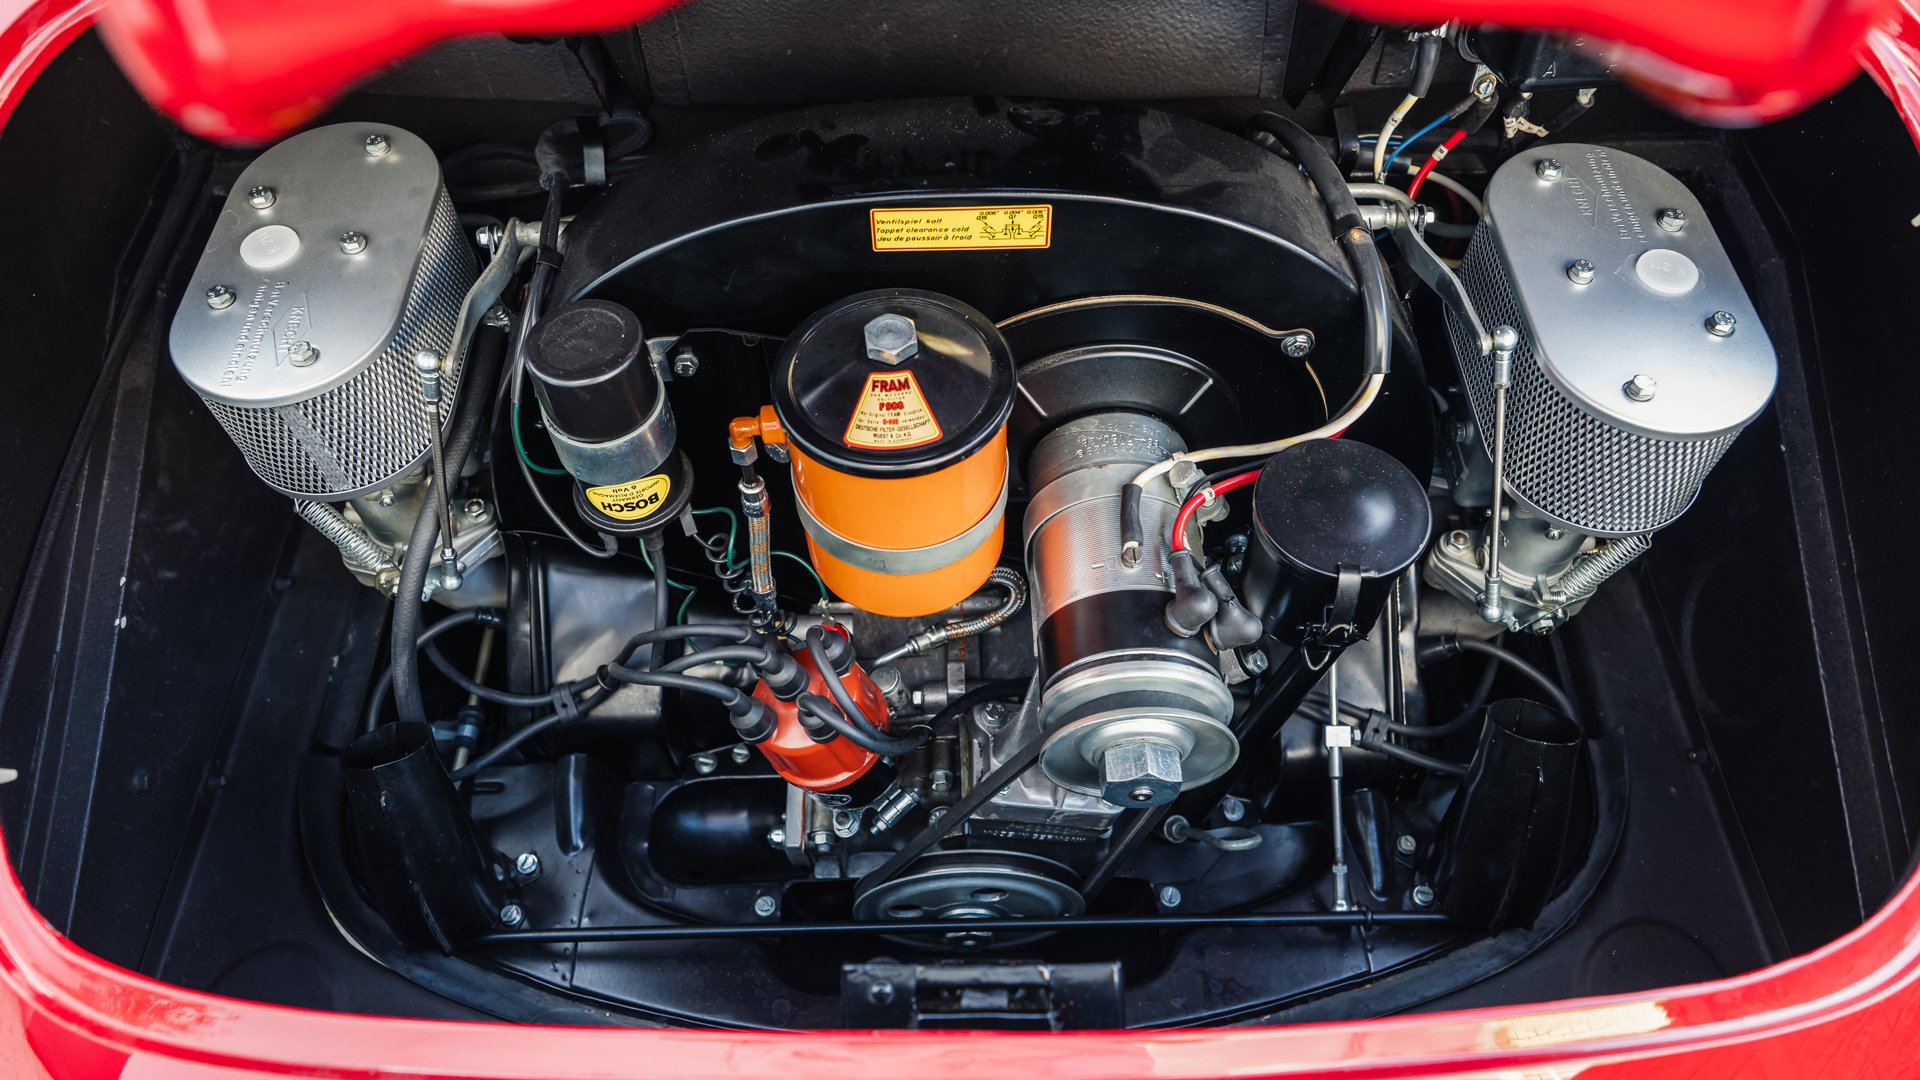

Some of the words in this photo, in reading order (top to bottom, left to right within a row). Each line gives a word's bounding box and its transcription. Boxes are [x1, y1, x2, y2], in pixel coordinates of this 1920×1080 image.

[871, 377, 911, 393] FRAM
[600, 492, 660, 512] BOSCH
[612, 493, 644, 502] GERMANY
